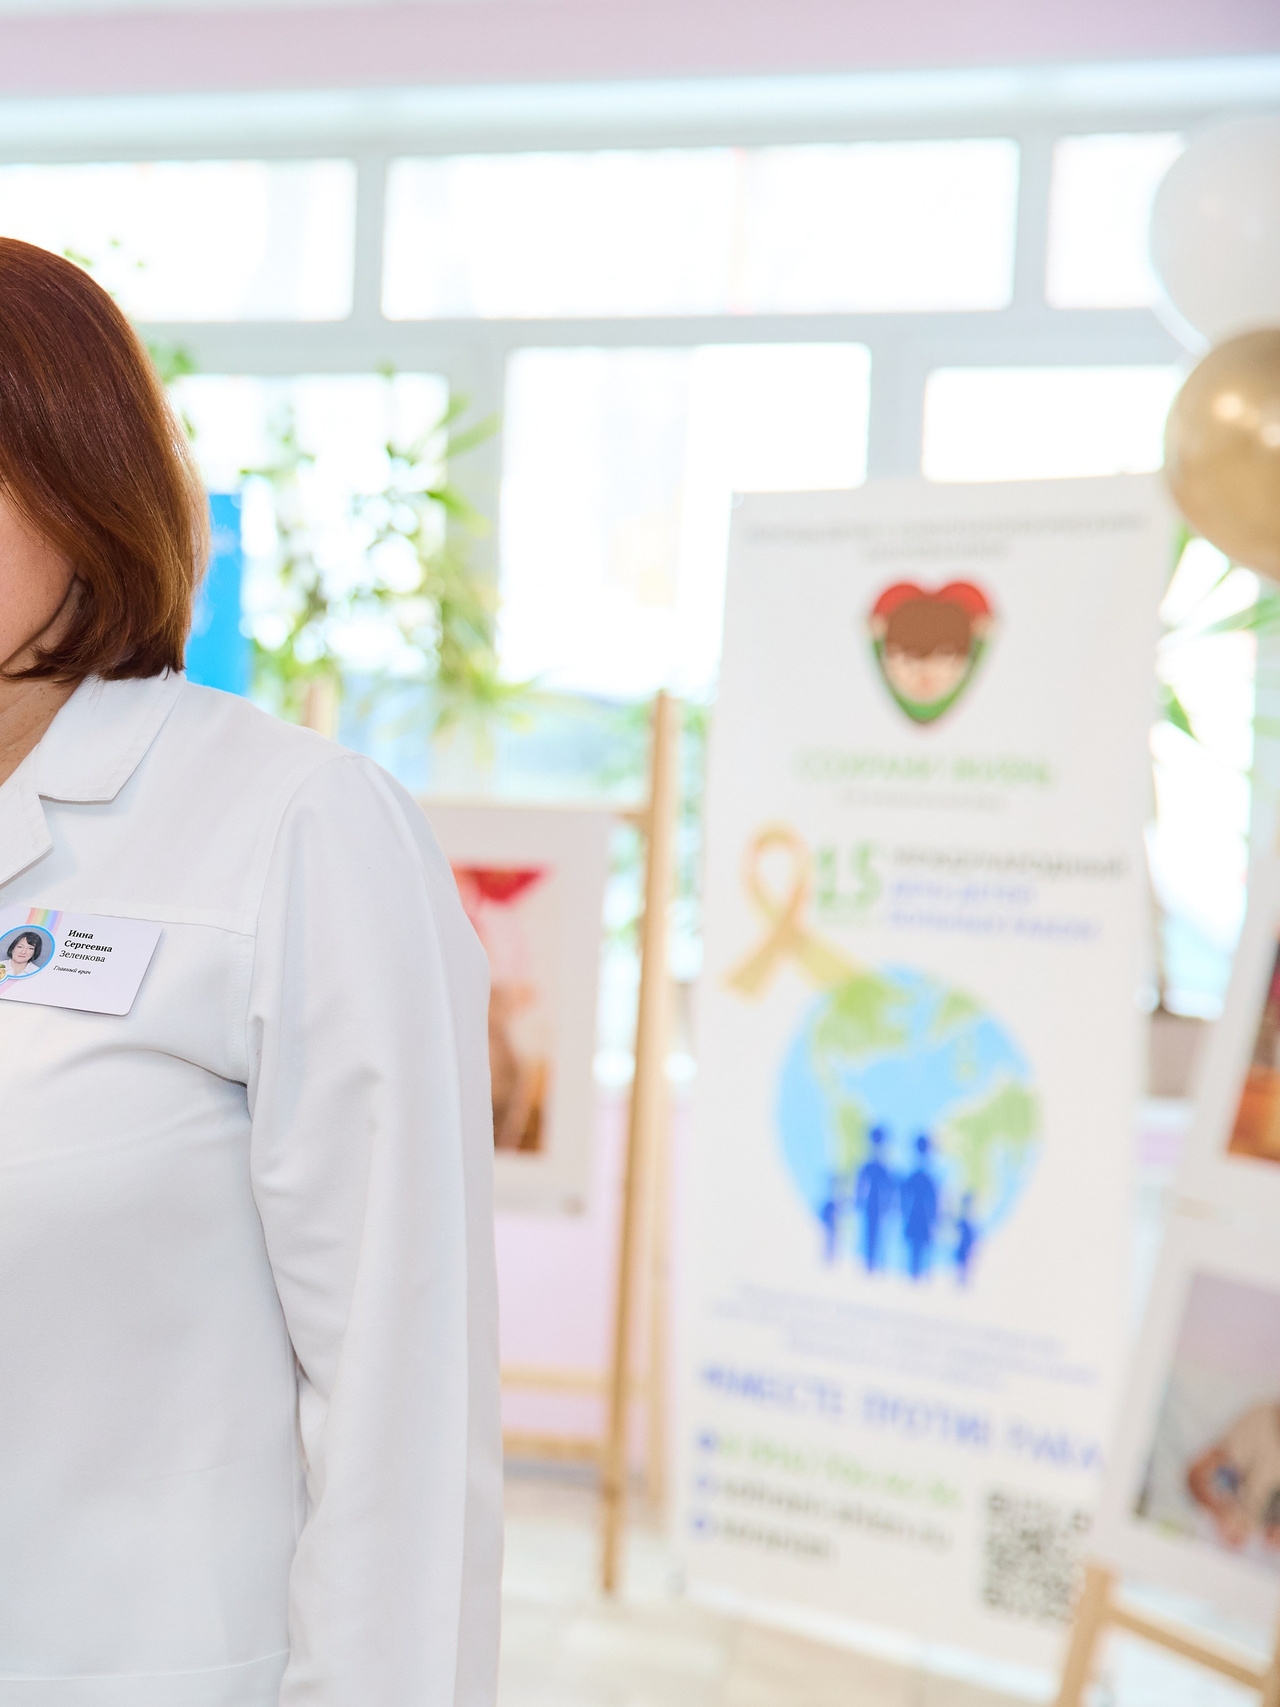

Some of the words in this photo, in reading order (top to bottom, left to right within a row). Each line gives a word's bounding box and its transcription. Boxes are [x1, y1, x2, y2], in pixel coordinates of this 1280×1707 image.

[67, 929, 94, 940] Инна
[64, 939, 113, 953] Сергеевна
[59, 949, 106, 963] Зеленкова
[53, 965, 77, 974] Главный
